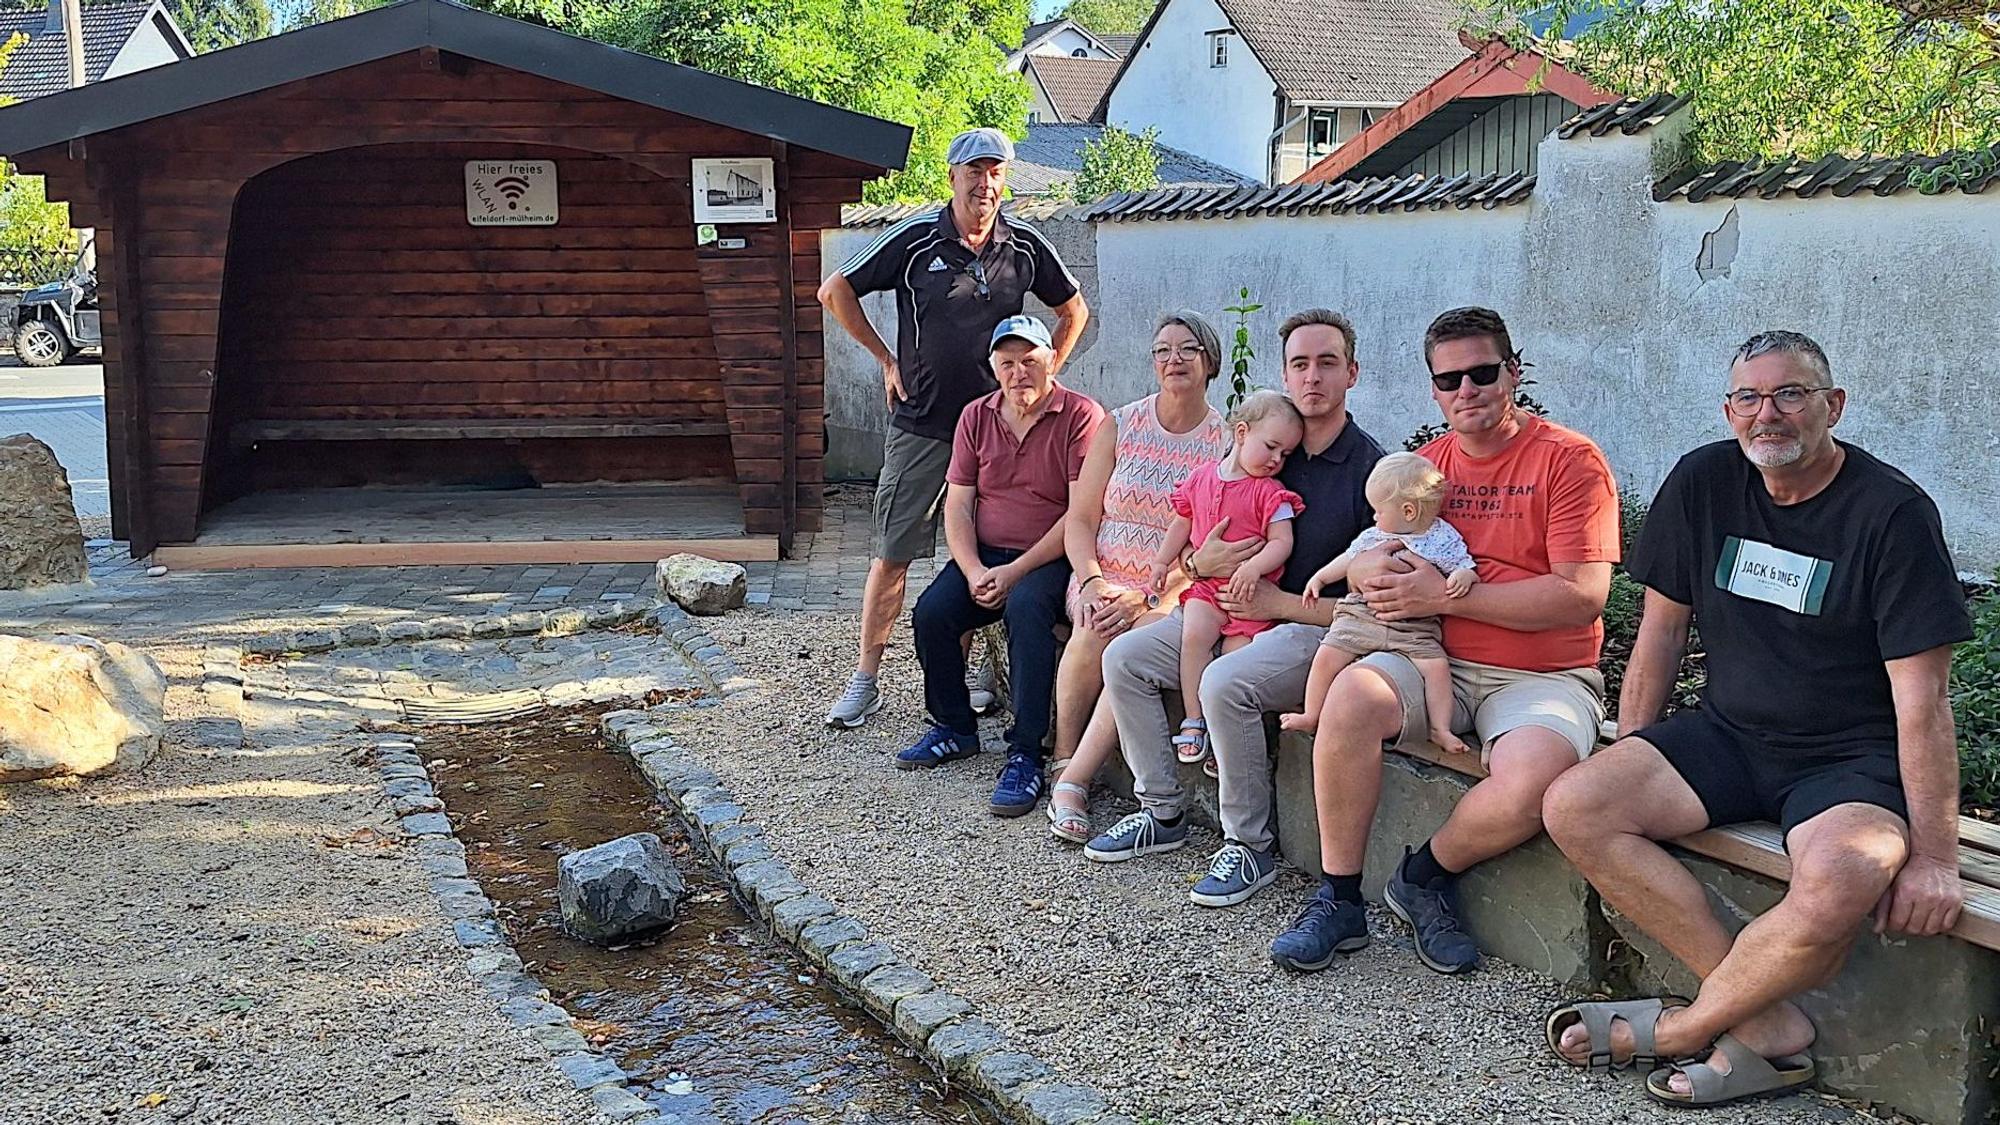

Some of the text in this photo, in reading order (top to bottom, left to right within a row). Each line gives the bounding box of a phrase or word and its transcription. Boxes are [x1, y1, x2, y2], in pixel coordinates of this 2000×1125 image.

[477, 163, 543, 175] Hier freies
[472, 178, 498, 214] WLAN
[1452, 485, 1499, 497] TAILOR
[1449, 499, 1473, 510] EST
[1741, 560, 1768, 578] JACK
[1769, 566, 1777, 580] &
